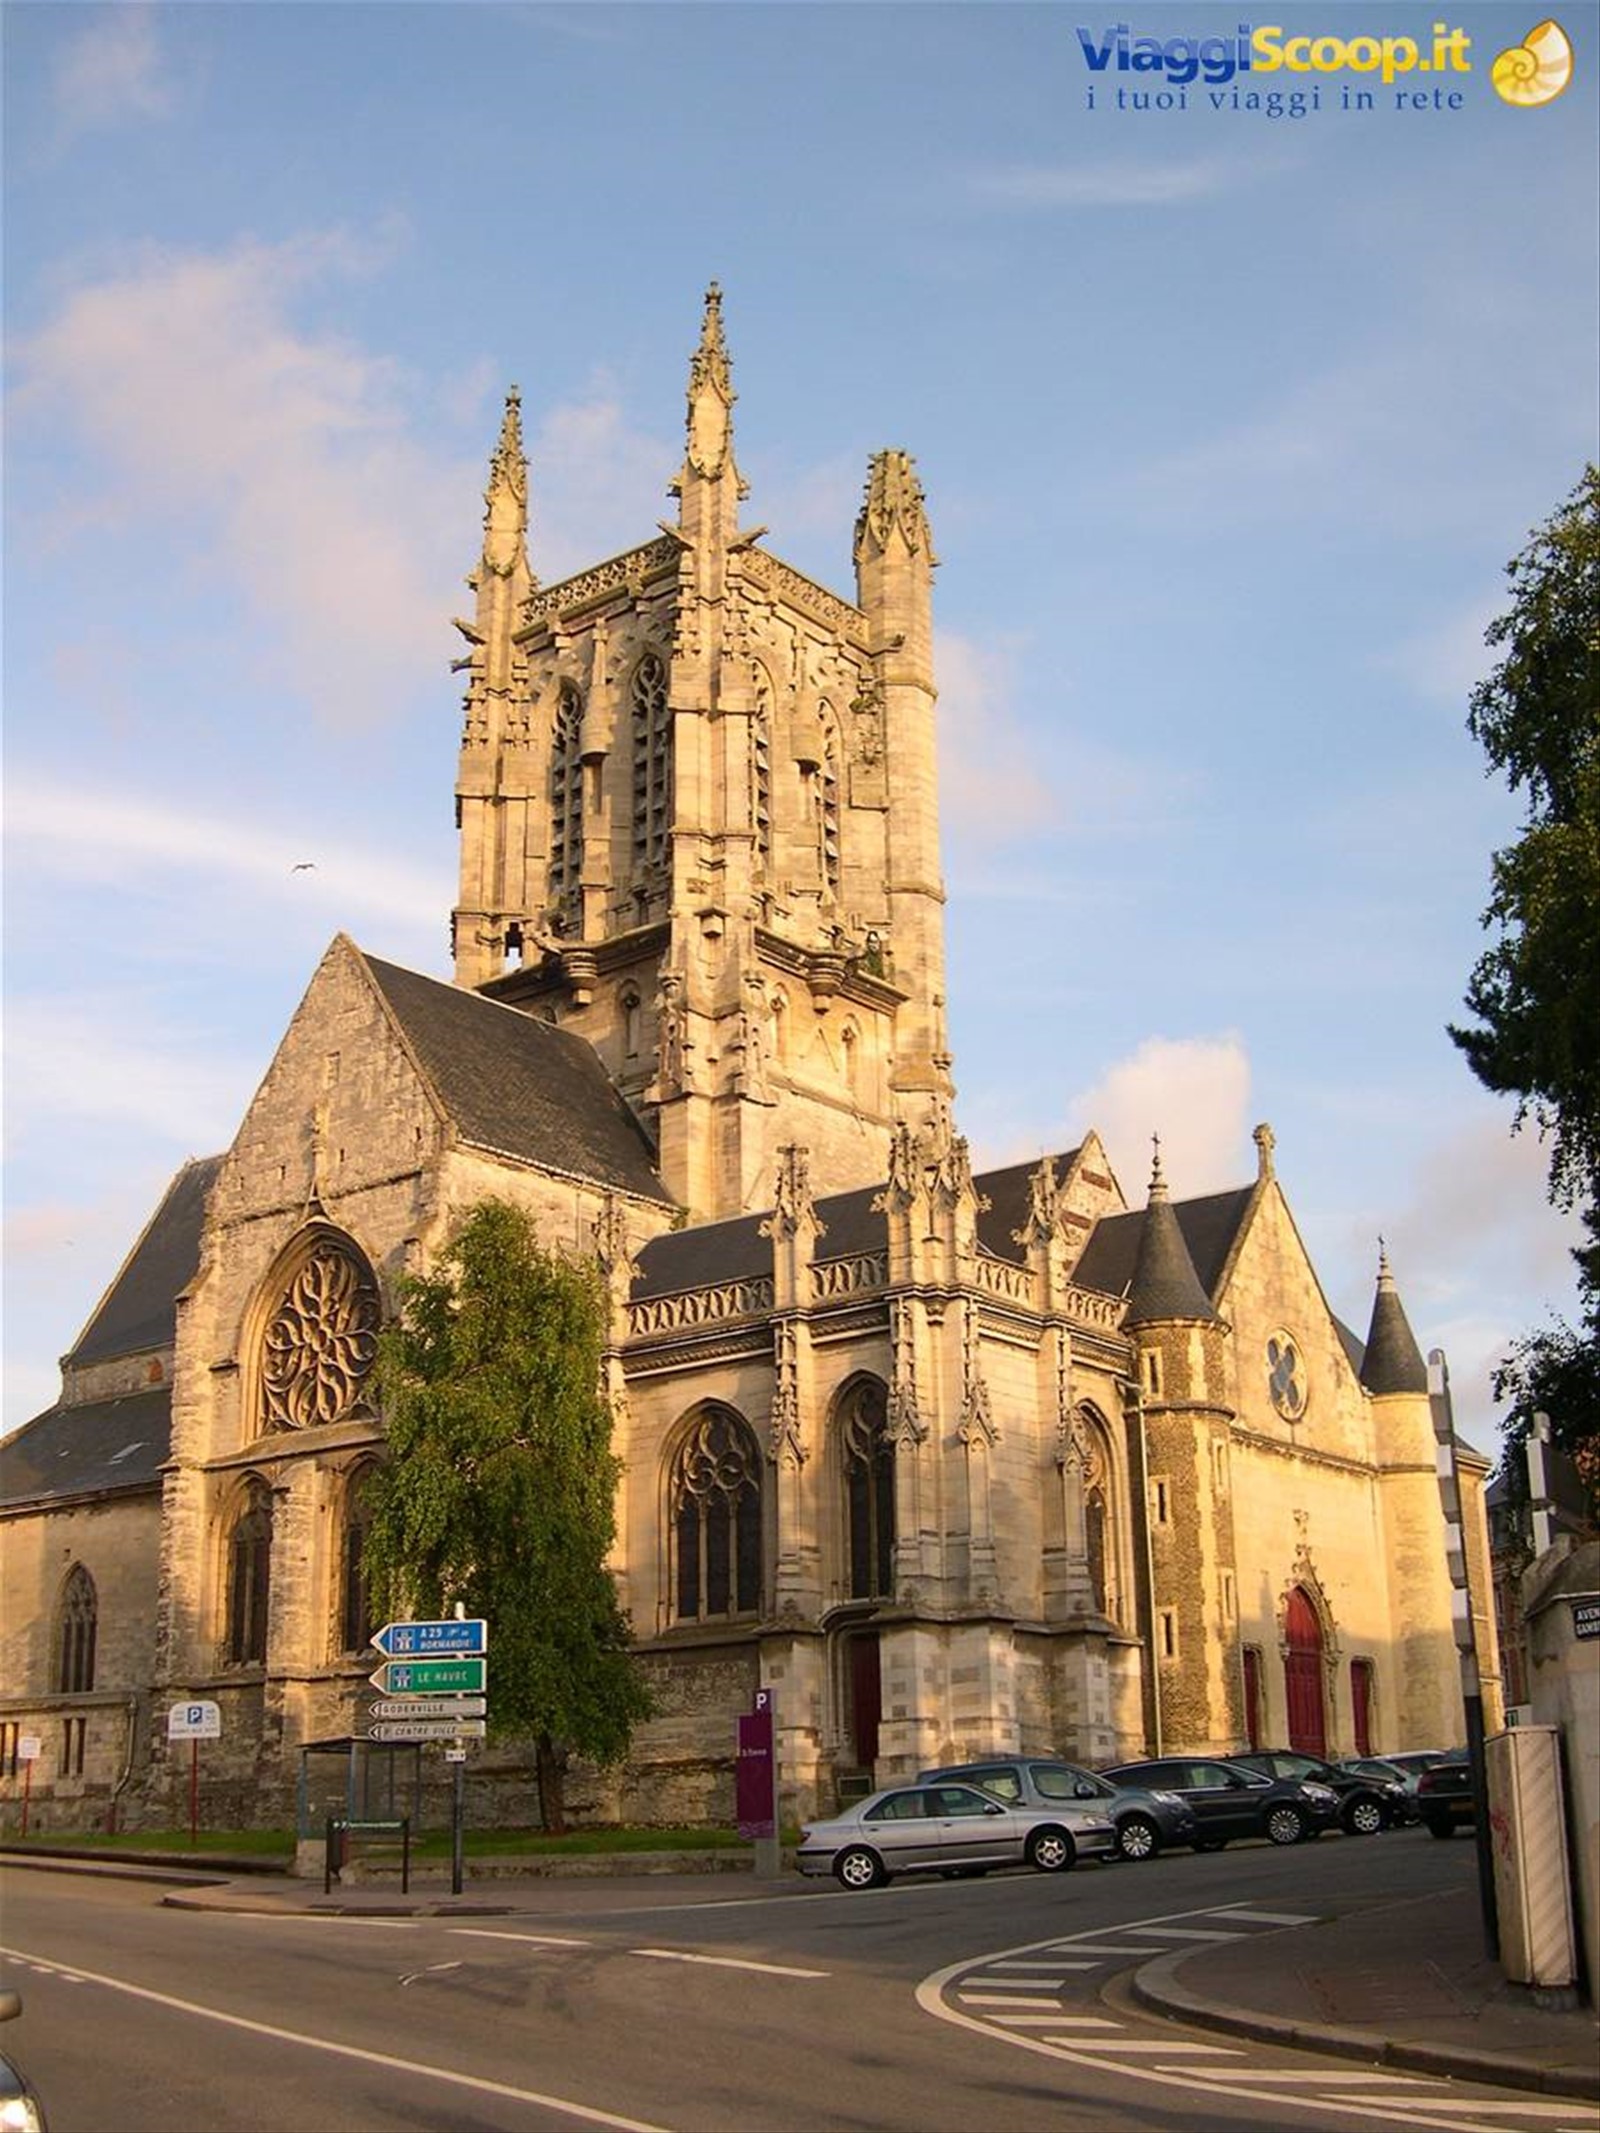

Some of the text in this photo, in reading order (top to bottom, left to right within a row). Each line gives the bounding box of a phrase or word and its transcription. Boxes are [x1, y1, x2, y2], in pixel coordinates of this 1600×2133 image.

[434, 1671, 467, 1682] HAVRE
[756, 1692, 767, 1709] P
[383, 1703, 444, 1713] GODERVILLE
